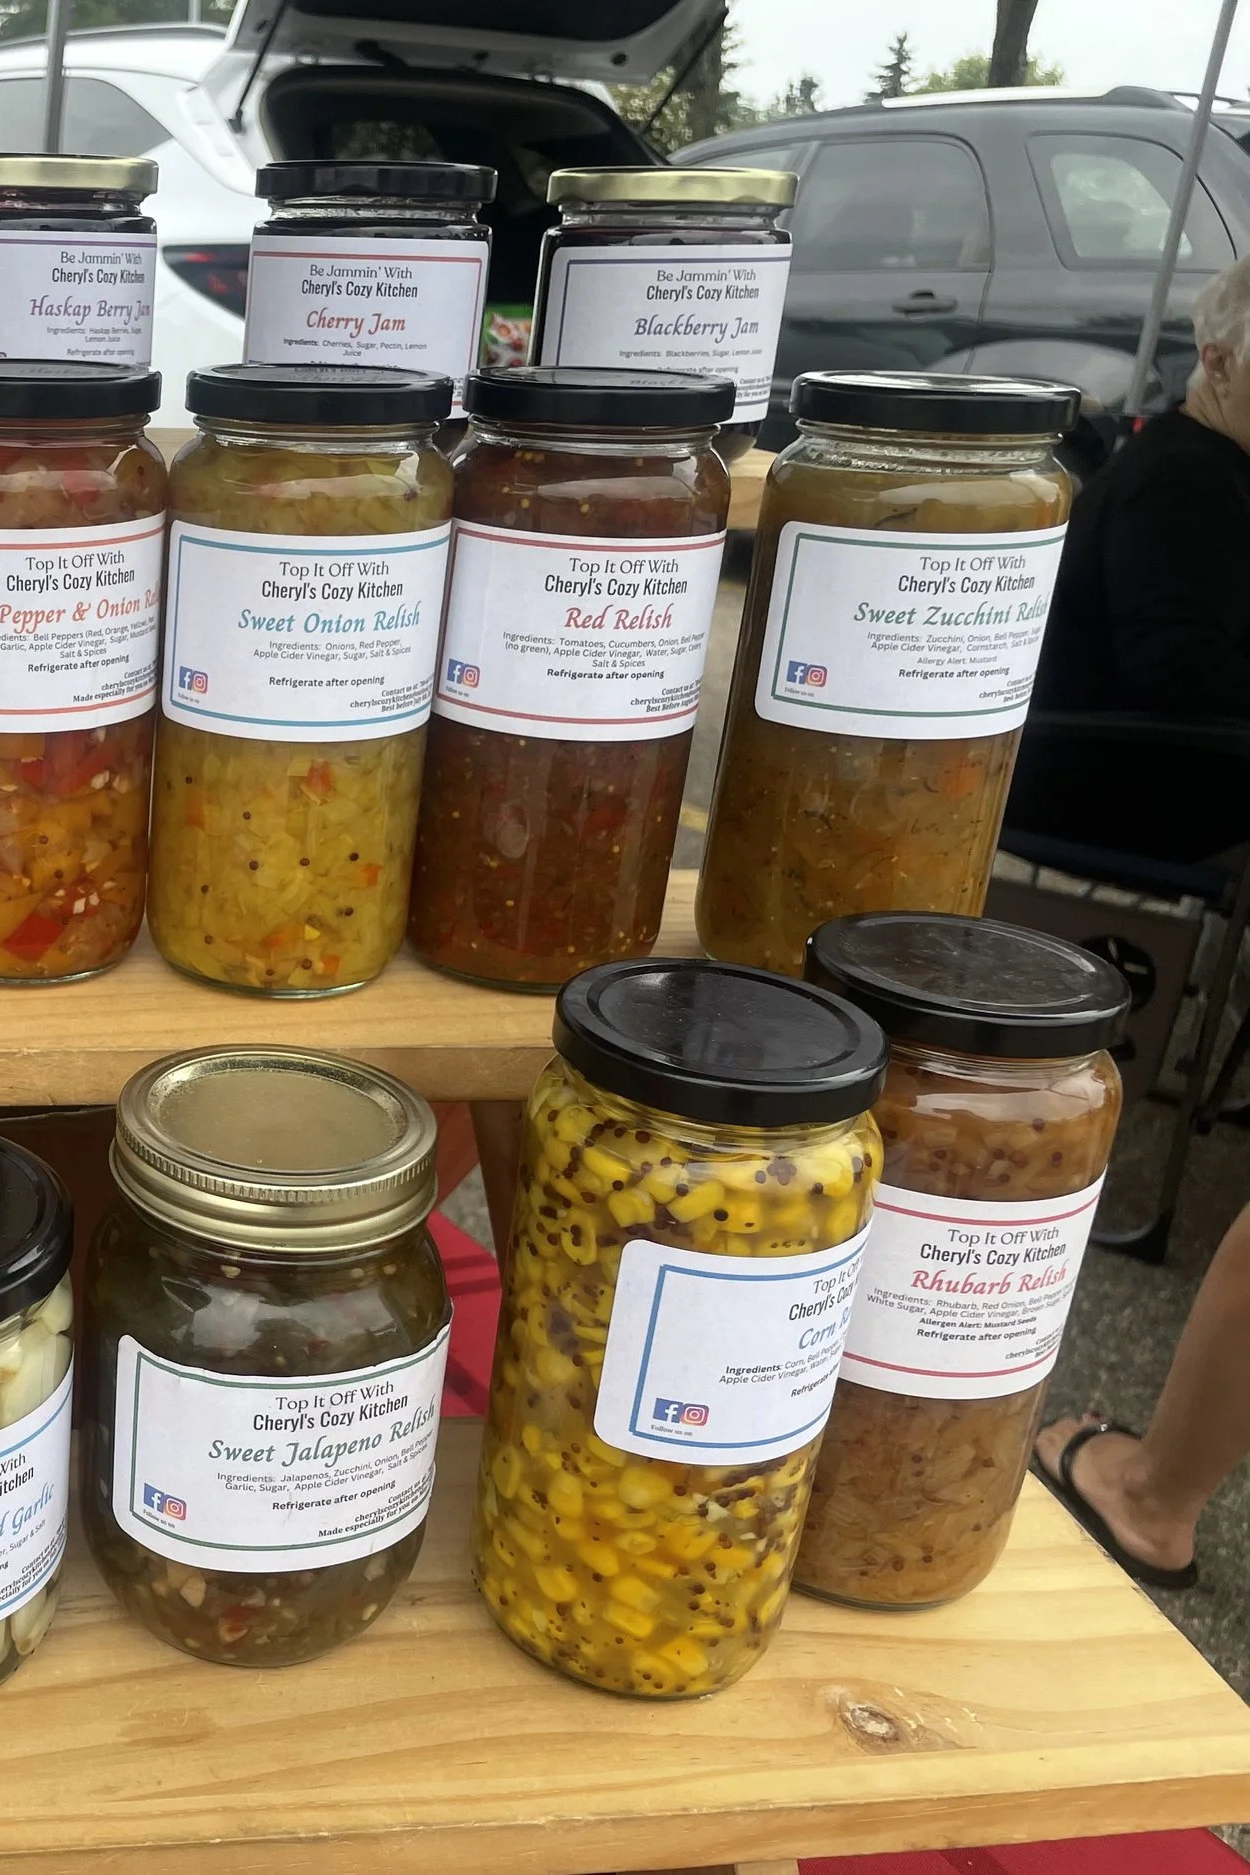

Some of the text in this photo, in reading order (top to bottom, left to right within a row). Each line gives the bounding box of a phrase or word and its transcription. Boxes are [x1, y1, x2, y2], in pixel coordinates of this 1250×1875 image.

[52, 268, 118, 285] Cheryl's Cozy
[657, 270, 756, 281] Be Jammin' With
[302, 280, 418, 298] Cheryl's Cozy Kitchen
[647, 286, 759, 302] Cheryl's Cozy Kitchen
[30, 295, 133, 325] Haskap Berry
[307, 308, 406, 338] Cherry Jam
[634, 314, 759, 343] Blackberry Jam
[6, 569, 135, 594] Cheryl's Cozy Kitchen
[261, 580, 403, 601] Cheryl's Cozy Kitchen
[545, 575, 687, 597] Cheryl's Cozy Kitchen
[72, 602, 91, 622] &
[97, 597, 140, 619] Onion
[238, 600, 421, 634] Sweet Onion Relish
[565, 603, 674, 630] Red Relish
[854, 601, 1014, 626] Sweet Zucchini
[269, 675, 385, 688] Refrigerate after opening
[911, 1259, 1069, 1295] Rhubarb Relish
[789, 1293, 835, 1321] Cheryl's
[798, 1321, 836, 1350] Corn
[919, 1318, 957, 1328] Allergen
[984, 1318, 1015, 1328] Mustard
[276, 1381, 394, 1412] Top It Off With
[253, 1395, 408, 1433] Cheryl's Cozy Kitchen
[208, 1394, 435, 1468] Sweet Jalapeno Relish
